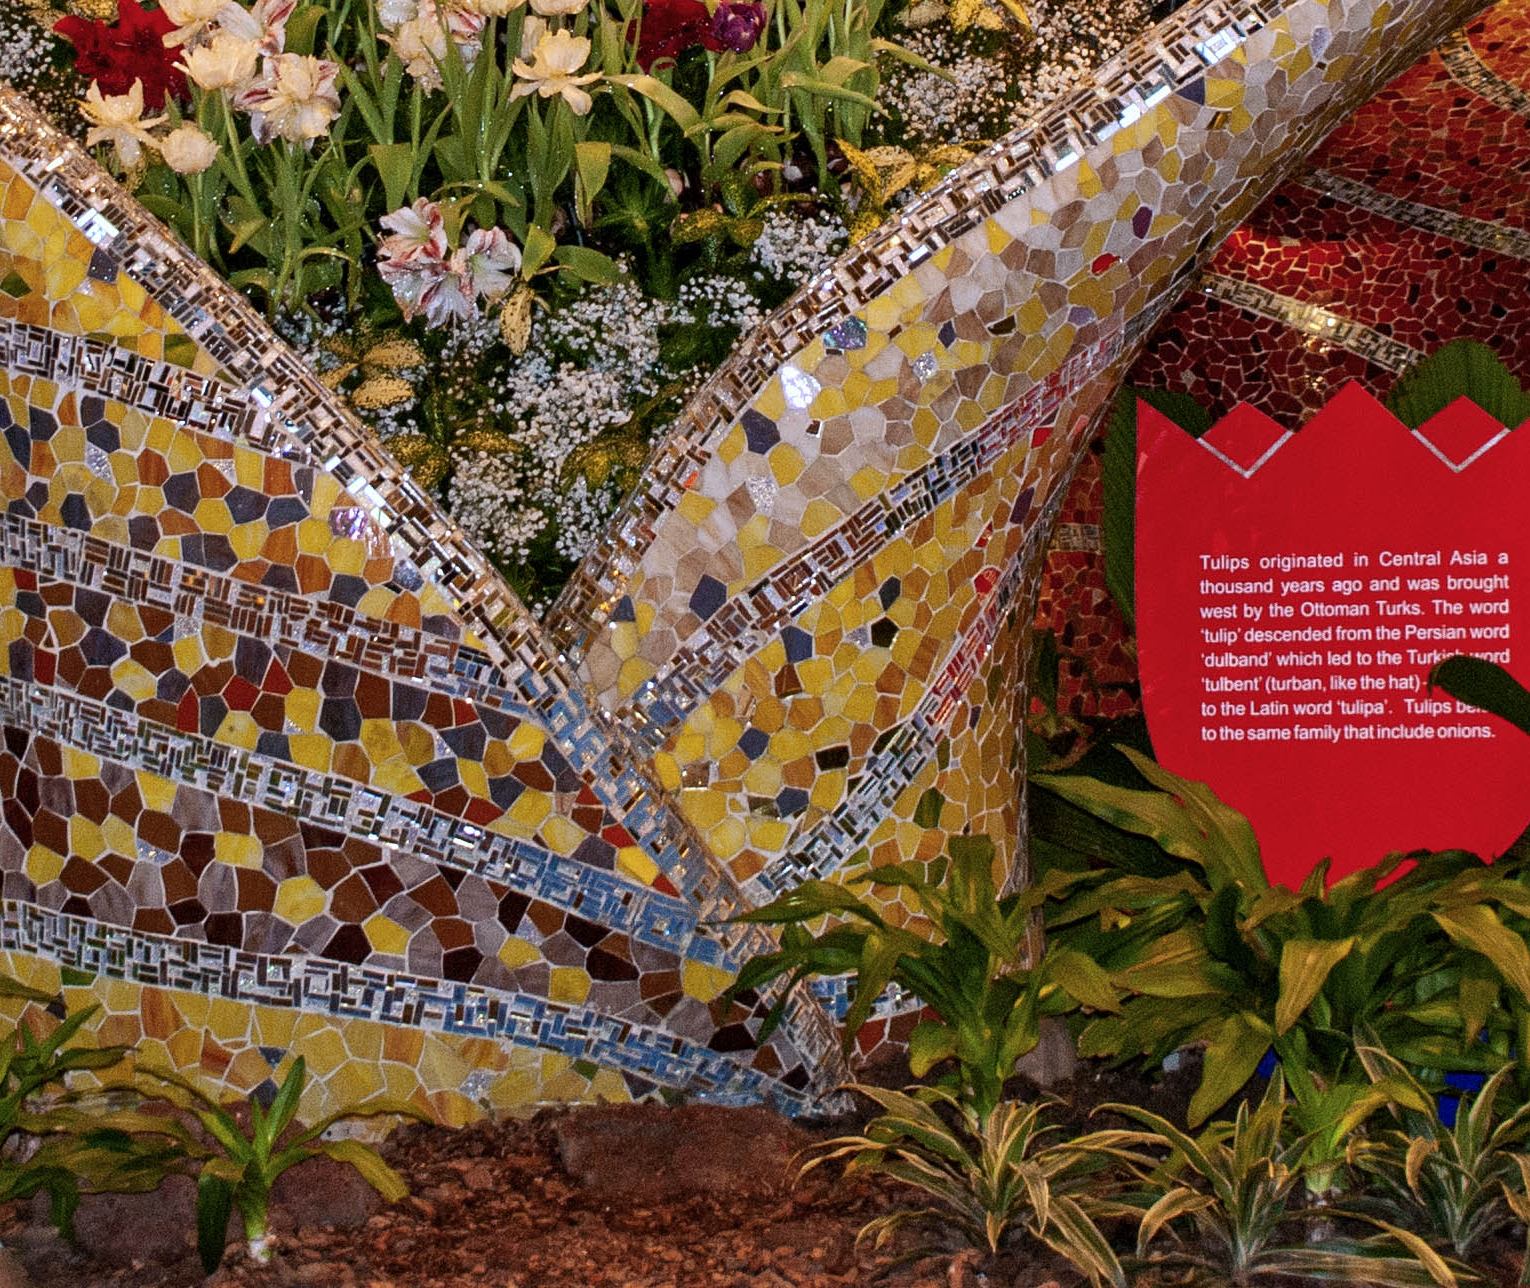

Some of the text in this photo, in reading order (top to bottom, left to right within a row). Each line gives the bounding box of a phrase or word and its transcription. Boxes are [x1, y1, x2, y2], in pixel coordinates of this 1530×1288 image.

[1199, 549, 1509, 573] Tulips originated in Central Asia a
[1199, 574, 1510, 597] thousand years ago and was brought
[1199, 598, 1510, 622] west by the Ottoman Turks. The word
[1243, 626, 1333, 643] descended
[1335, 625, 1373, 641] from
[1375, 624, 1402, 641] the
[1404, 624, 1467, 641] Persian
[1469, 623, 1510, 640] word
[1275, 650, 1323, 667] which
[1327, 650, 1352, 666] led
[1356, 650, 1373, 666] to
[1376, 650, 1403, 666] the
[1265, 675, 1327, 694] (turban,
[1329, 674, 1358, 691] like
[1359, 674, 1387, 690] the
[1388, 674, 1421, 693] hat)
[1201, 702, 1217, 717] to
[1220, 701, 1246, 717] the
[1249, 700, 1289, 716] Latin
[1292, 699, 1333, 716] word
[1403, 698, 1453, 718] Tulips
[1201, 723, 1496, 744] to the same family that include onions.
